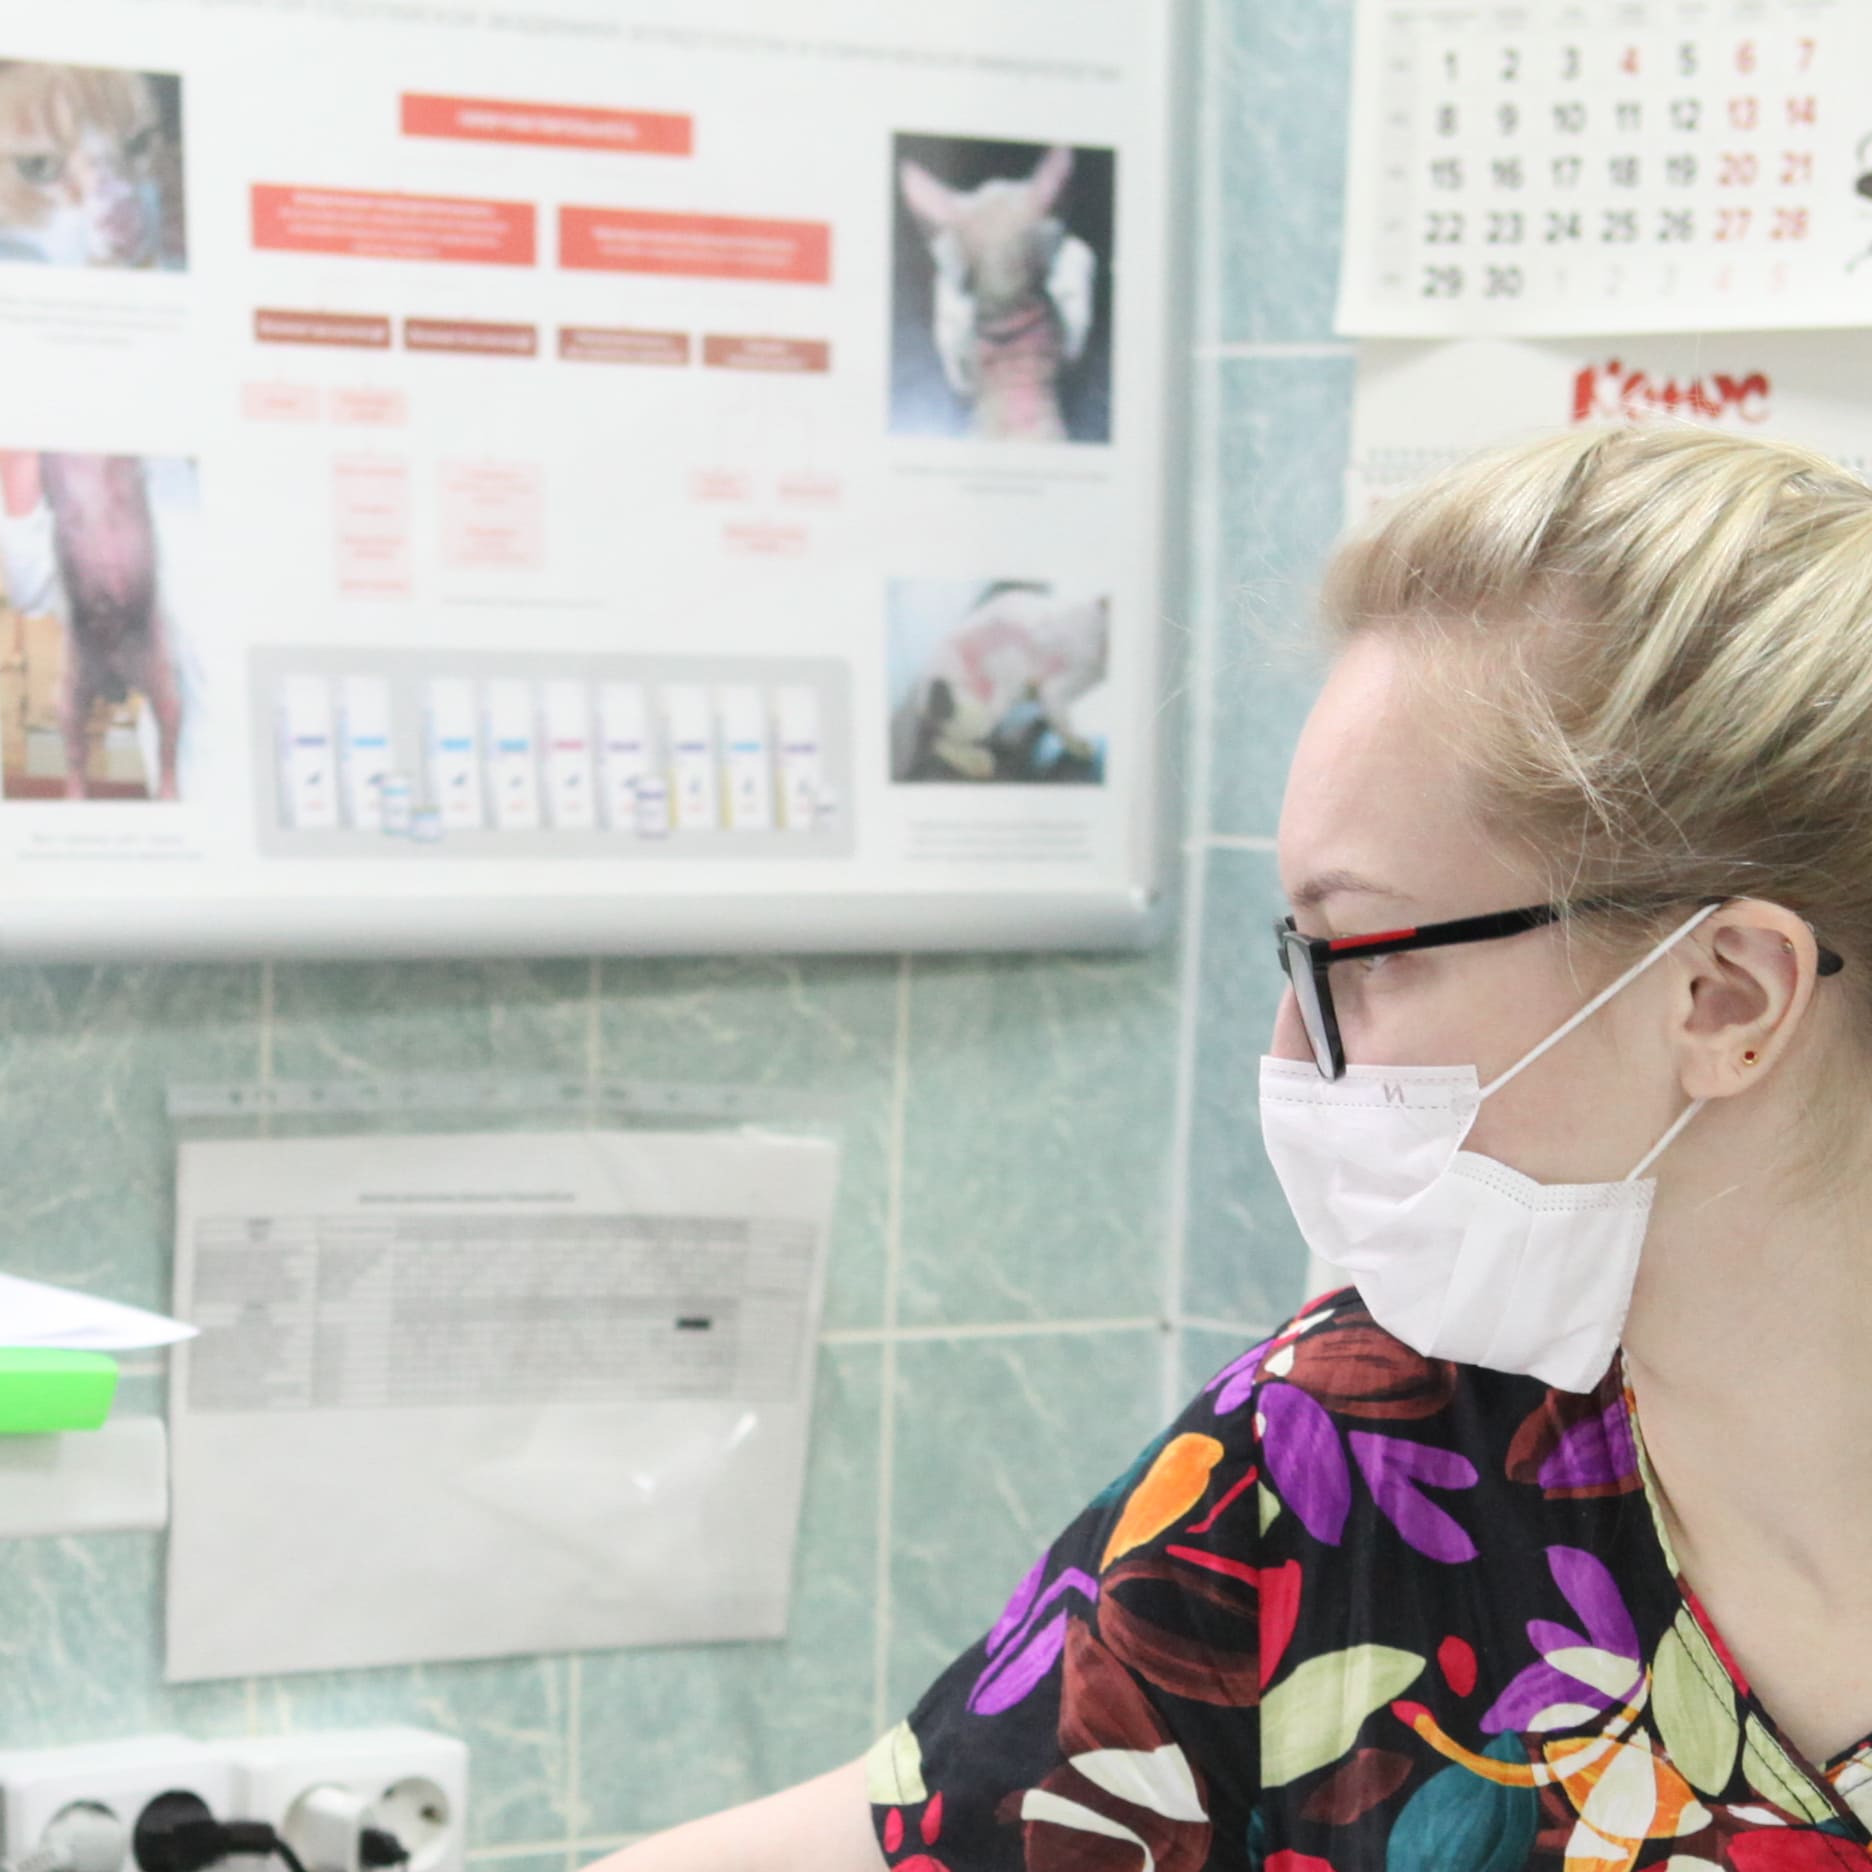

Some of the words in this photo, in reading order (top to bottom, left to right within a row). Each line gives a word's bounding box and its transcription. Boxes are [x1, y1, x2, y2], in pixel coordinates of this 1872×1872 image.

[1444, 49, 1459, 82] 1
[1500, 46, 1521, 81] 2
[1560, 45, 1581, 81] 3
[1619, 43, 1641, 76] 4
[1677, 41, 1697, 77] 5
[1735, 38, 1757, 75] 6
[1796, 36, 1816, 73] 7
[1437, 101, 1458, 138] 8
[1496, 100, 1519, 136] 9
[1552, 100, 1586, 134] 10
[1615, 100, 1642, 132] 11
[1669, 97, 1702, 132] 12
[1727, 95, 1759, 131] 13
[1786, 95, 1817, 126] 14
[1430, 156, 1464, 191] 15
[1491, 155, 1524, 190] 16
[1551, 154, 1583, 189] 17
[1609, 153, 1640, 188] 18
[1664, 152, 1698, 188] 19
[1717, 150, 1759, 187] 20
[1779, 149, 1814, 186] 21
[1424, 210, 1465, 244] 22
[1486, 209, 1524, 244] 23
[1544, 209, 1582, 243] 24
[1601, 208, 1639, 243] 25
[1658, 208, 1695, 243] 26
[1713, 207, 1753, 241] 27
[1770, 206, 1809, 241] 28
[1422, 264, 1464, 299] 29
[1484, 264, 1524, 299] 30
